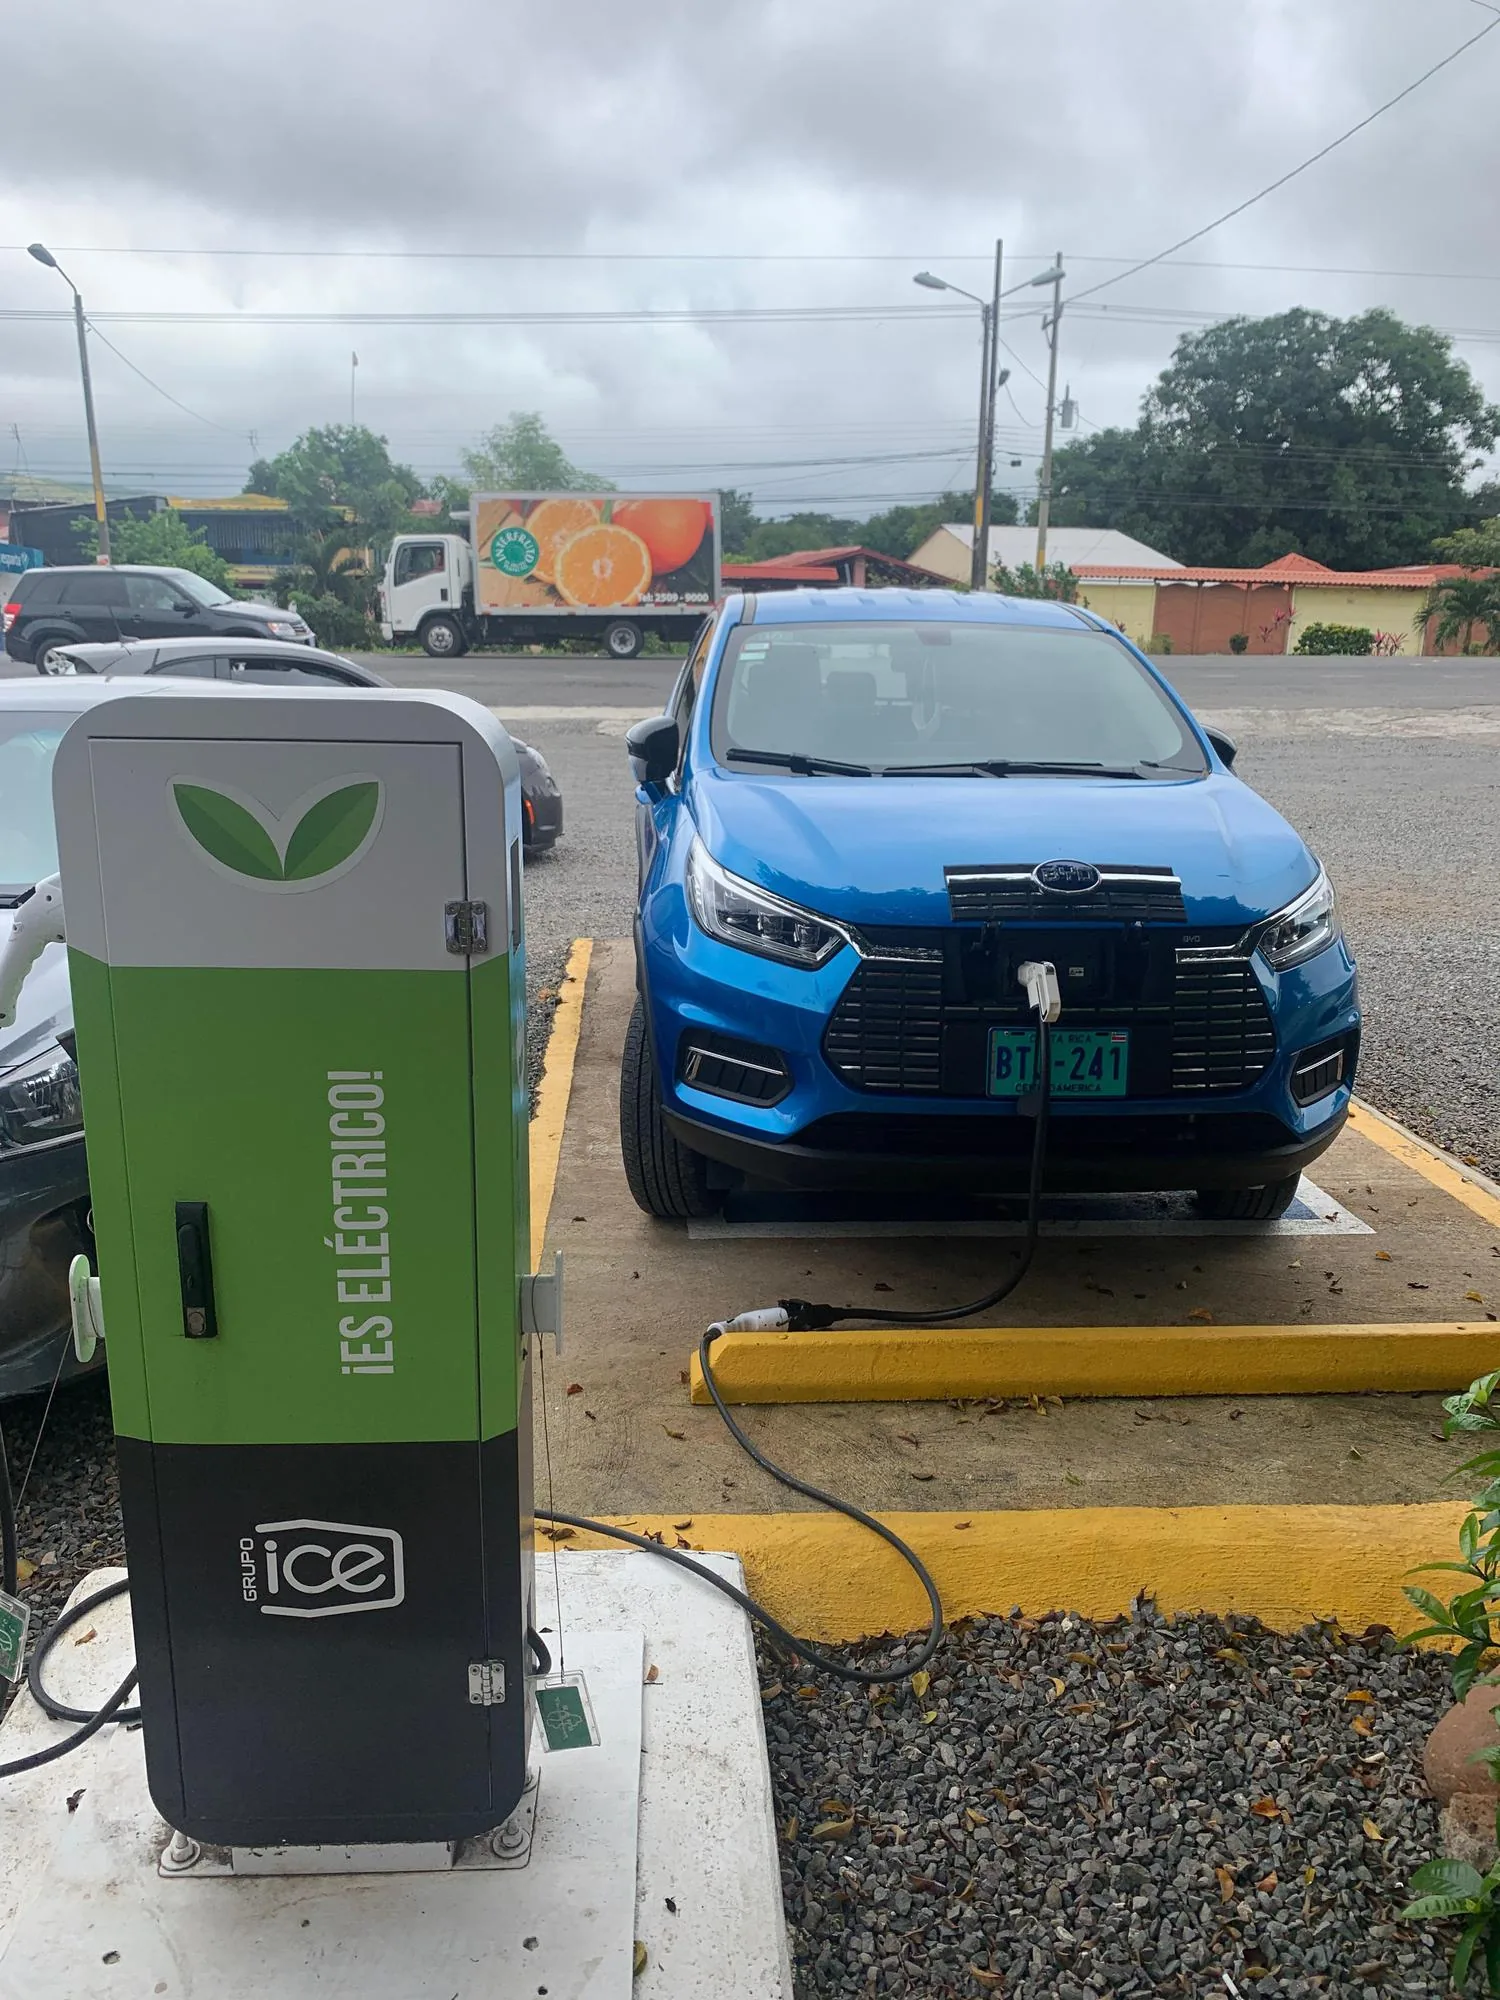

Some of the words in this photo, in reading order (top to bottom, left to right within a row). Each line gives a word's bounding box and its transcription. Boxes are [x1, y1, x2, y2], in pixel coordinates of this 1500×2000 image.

[639, 592, 654, 602] Tel:
[655, 592, 678, 602] 2509
[684, 592, 709, 602] 9000
[996, 1046, 1121, 1081] BT-241
[1068, 1034, 1092, 1044] RICA
[323, 1071, 392, 1303] ELÉCTRICO!
[338, 1315, 394, 1374] ¡ES
[240, 1537, 258, 1602] GRUPO
[264, 1539, 387, 1594] ice
